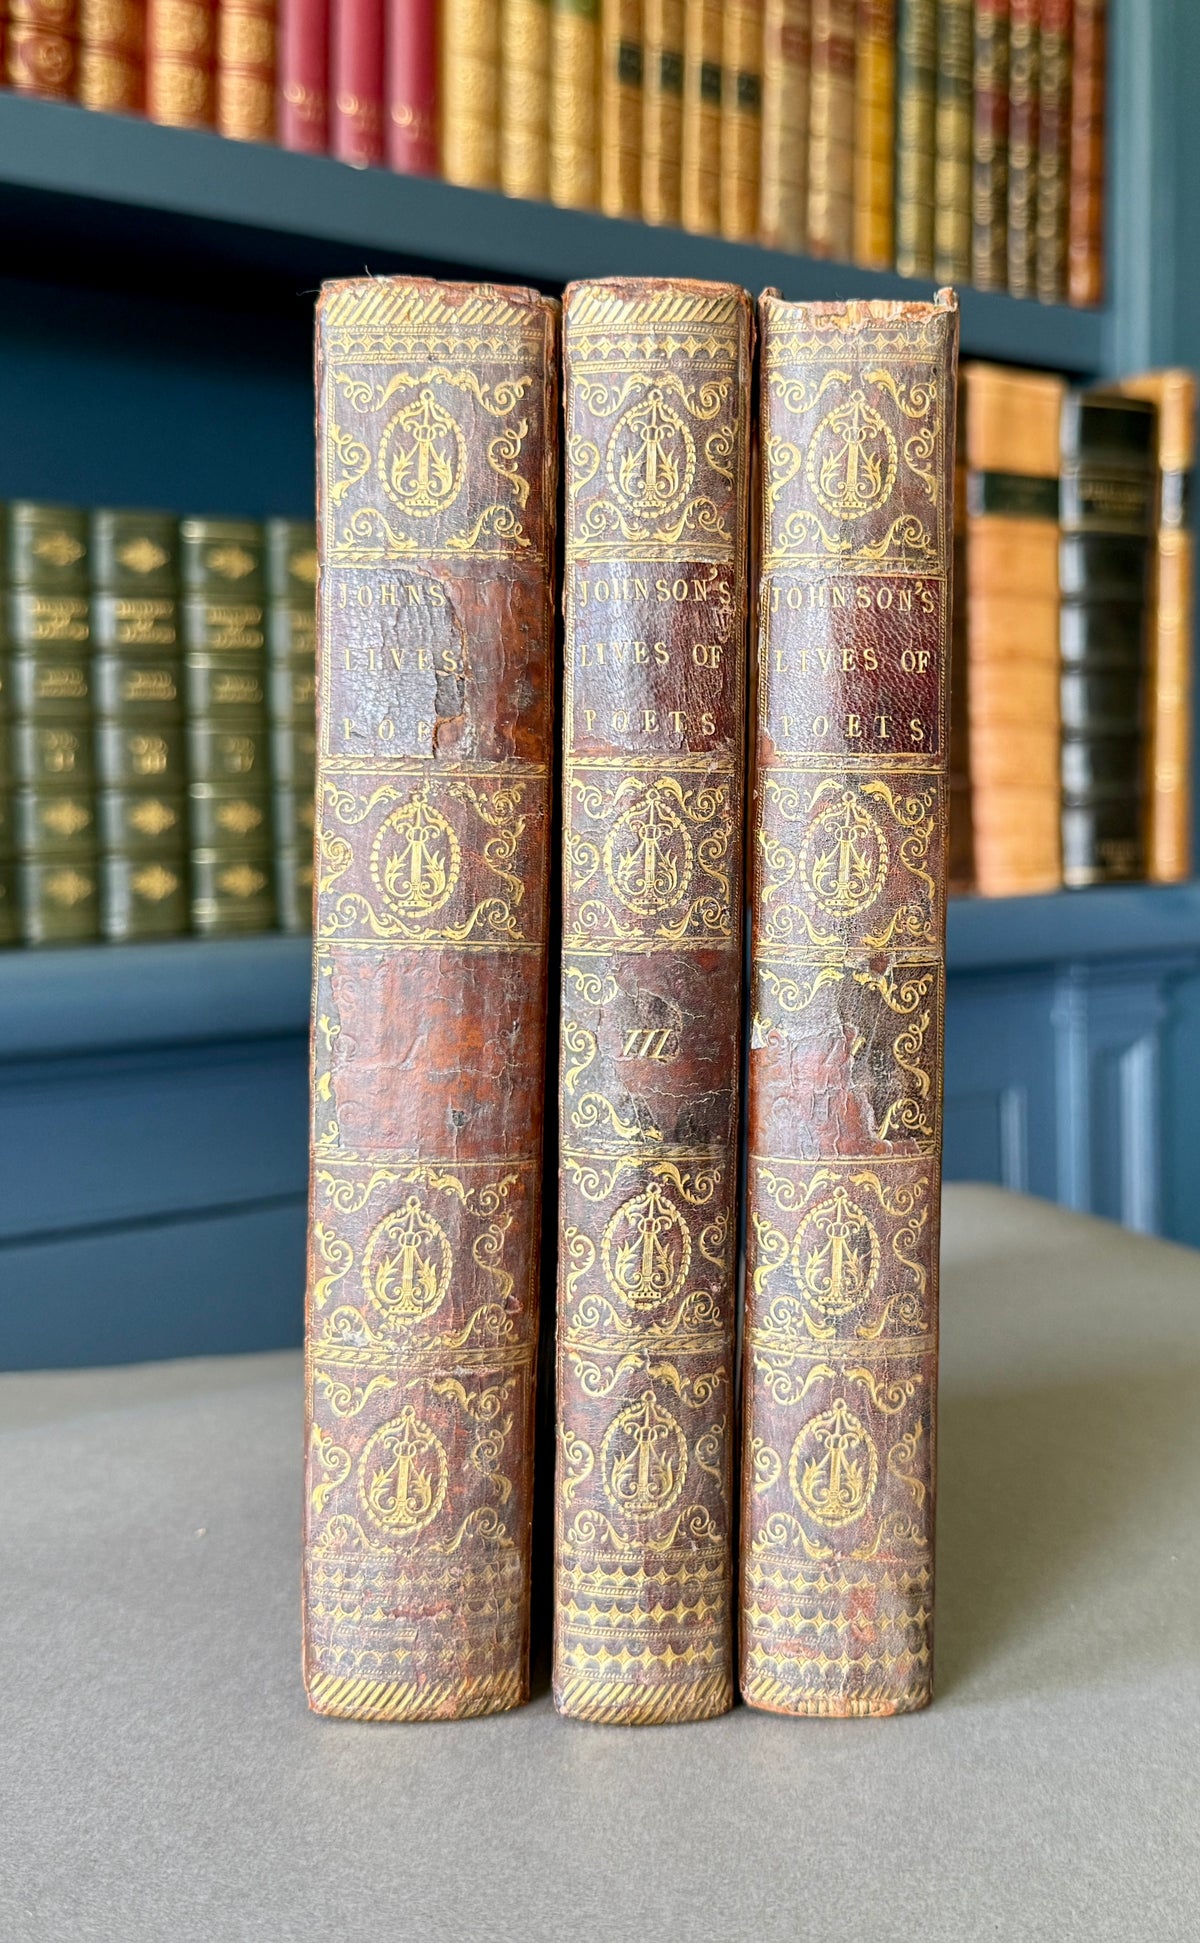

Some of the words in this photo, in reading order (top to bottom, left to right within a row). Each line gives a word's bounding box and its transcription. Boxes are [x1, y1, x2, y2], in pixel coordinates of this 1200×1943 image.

[579, 567, 731, 607] JOHNSON'S
[771, 581, 935, 613] JOHNSON'S
[344, 649, 457, 672] LIVES
[580, 641, 670, 667] LIVES
[692, 644, 723, 669] OF
[775, 648, 879, 673] LIVES
[901, 650, 931, 674] OF
[584, 709, 716, 736] POETS
[780, 714, 925, 741] POETS
